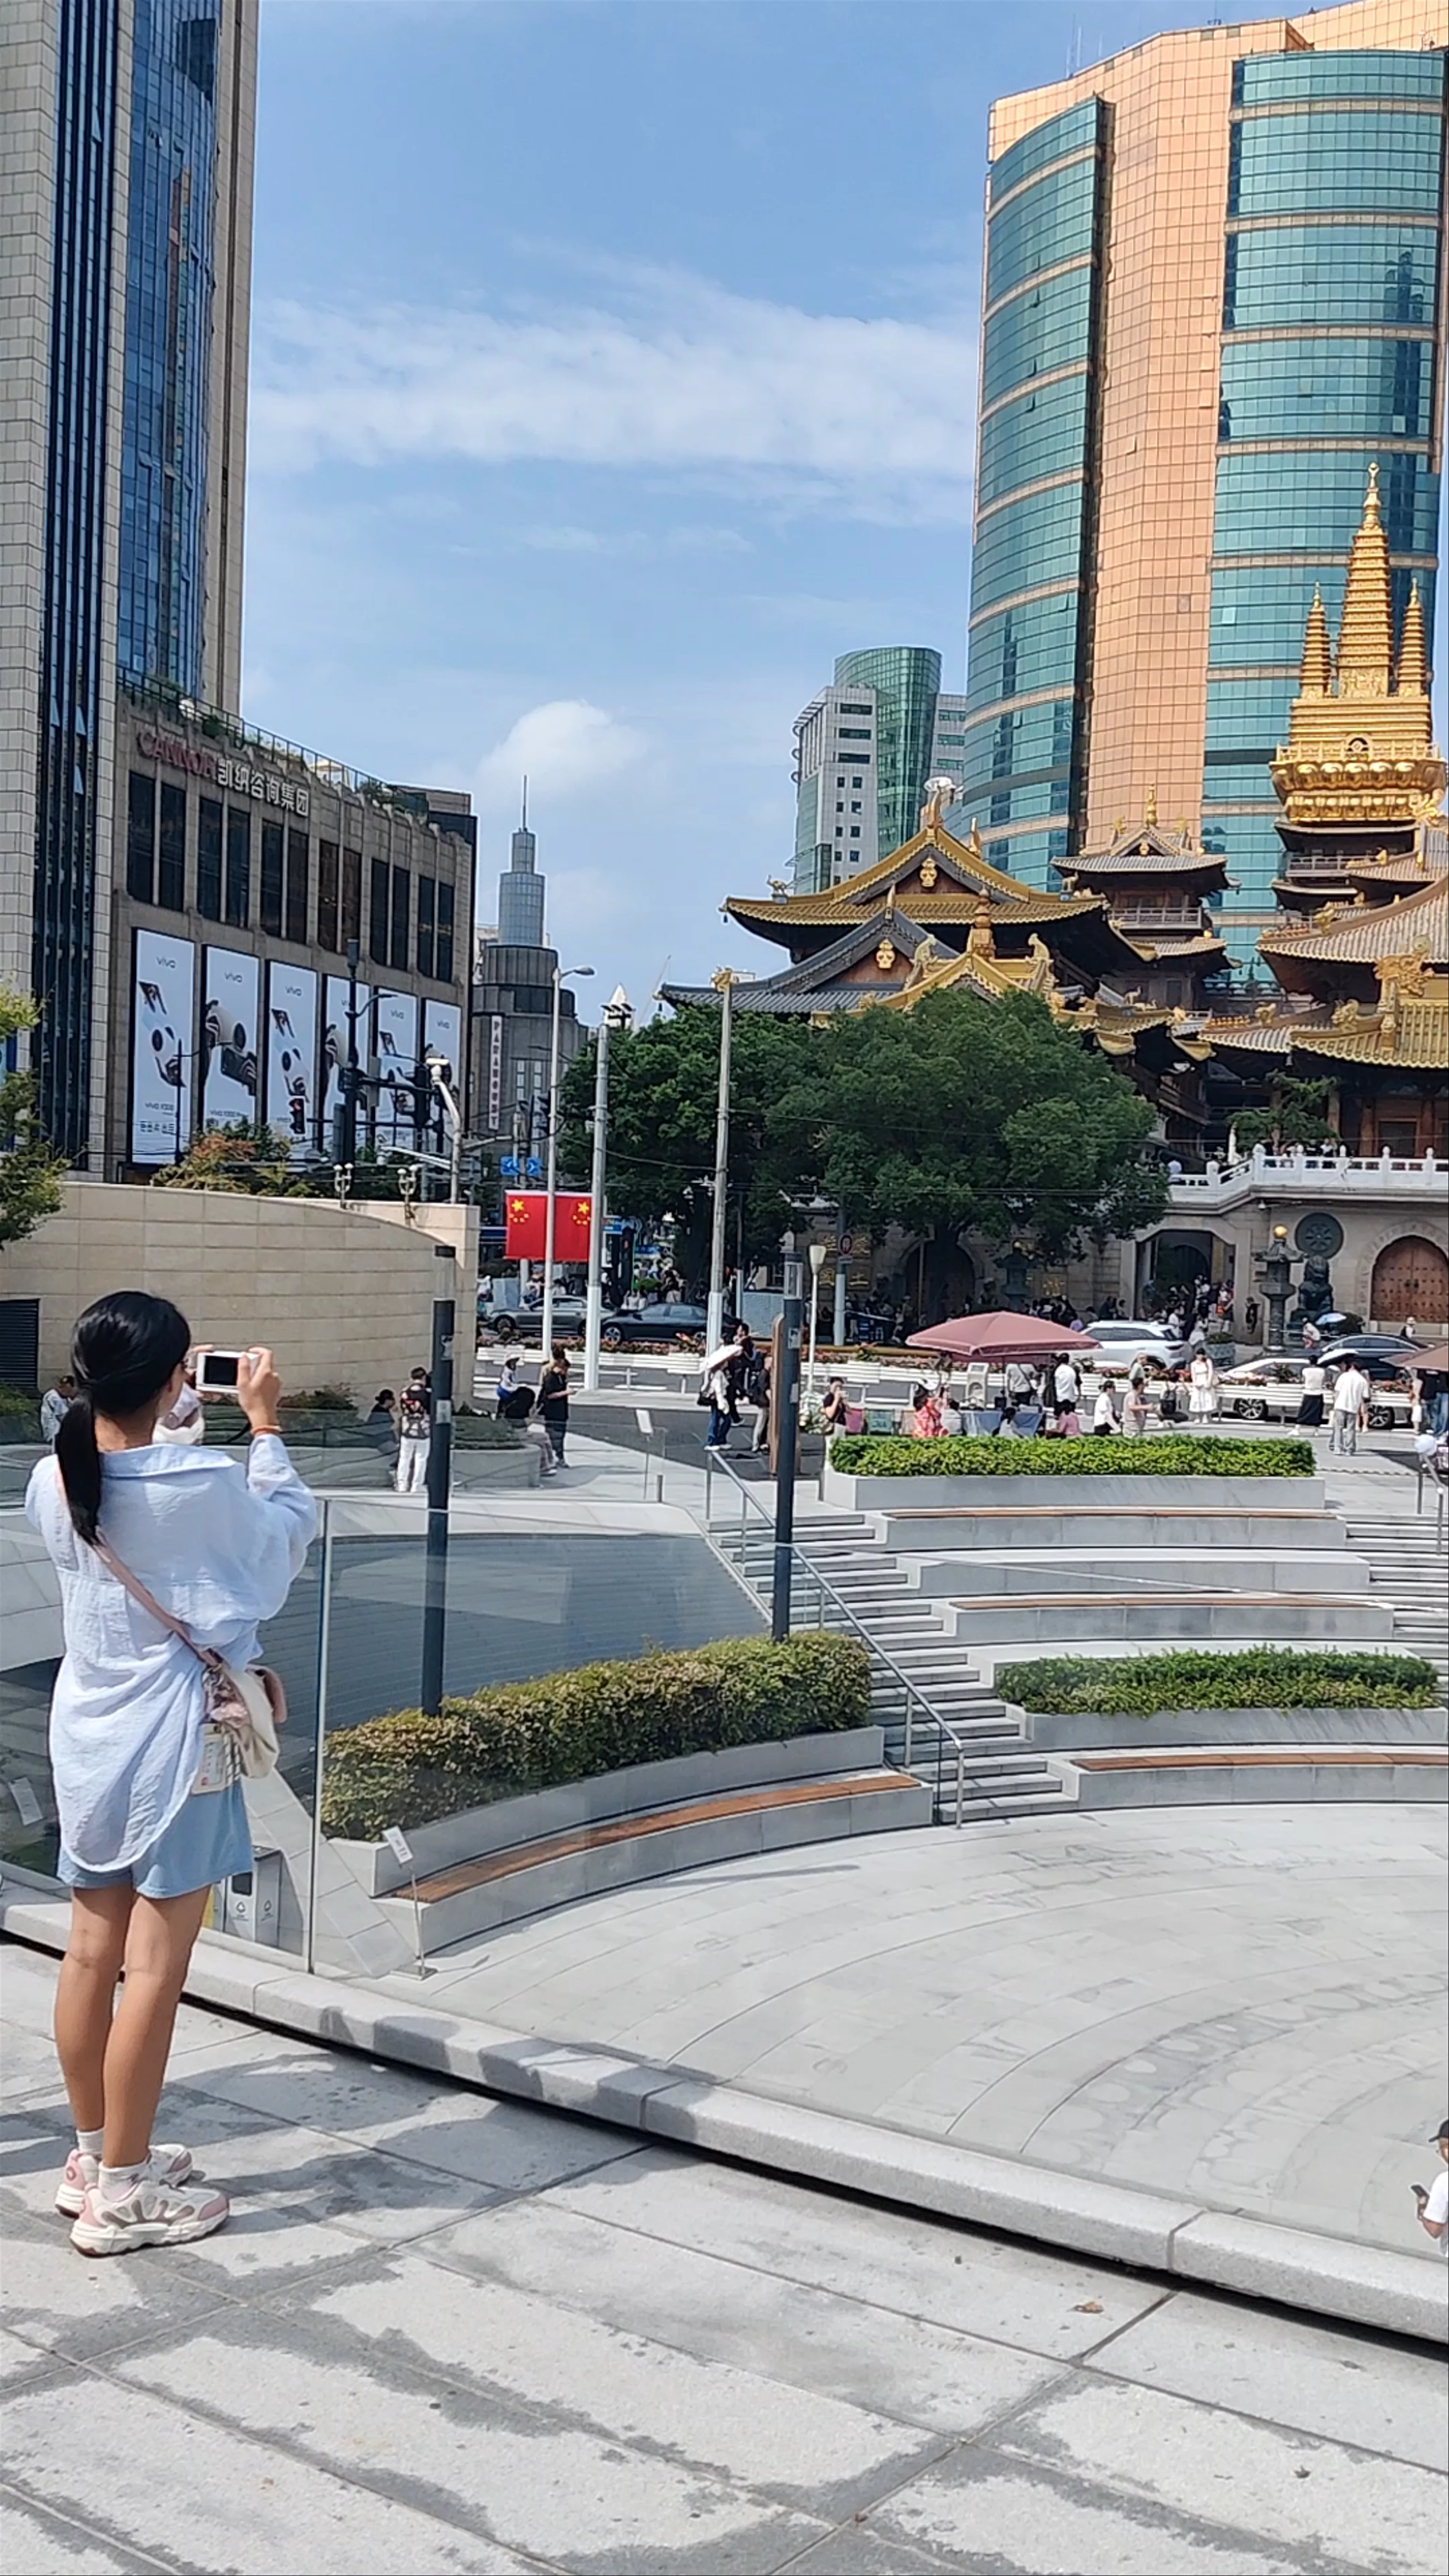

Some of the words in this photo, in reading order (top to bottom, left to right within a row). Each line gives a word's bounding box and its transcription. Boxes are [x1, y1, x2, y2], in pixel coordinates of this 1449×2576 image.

[218, 758, 309, 817] 凯纳咨询集团
[156, 956, 175, 968] vivo
[225, 972, 242, 983] vivo
[285, 986, 301, 997] vivo
[391, 1009, 404, 1019] vivo
